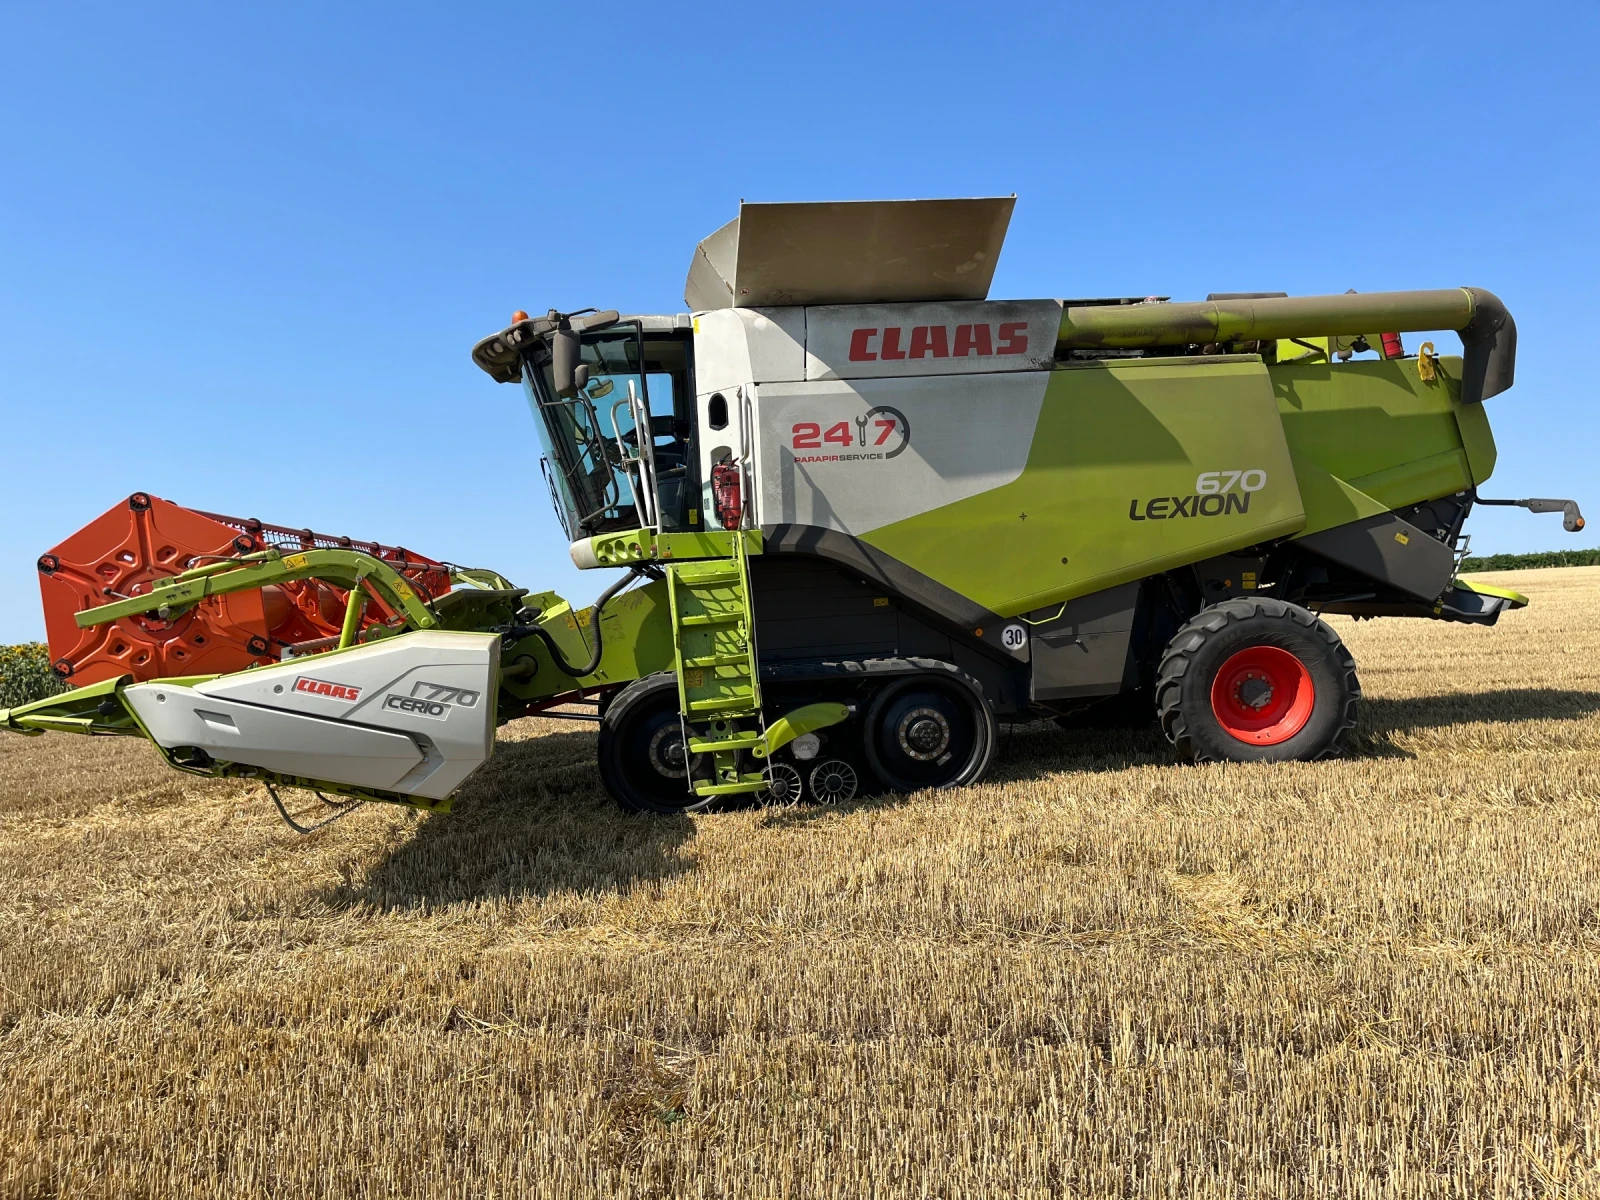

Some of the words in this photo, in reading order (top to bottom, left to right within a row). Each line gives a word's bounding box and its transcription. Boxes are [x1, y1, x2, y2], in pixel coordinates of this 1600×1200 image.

[848, 322, 1028, 362] CLAAS
[1195, 469, 1267, 495] 670
[1129, 492, 1251, 521] LEXION
[1005, 629, 1023, 646] 30
[296, 679, 360, 701] CLAAS
[424, 686, 478, 706] 770
[387, 697, 444, 717] CERIO
